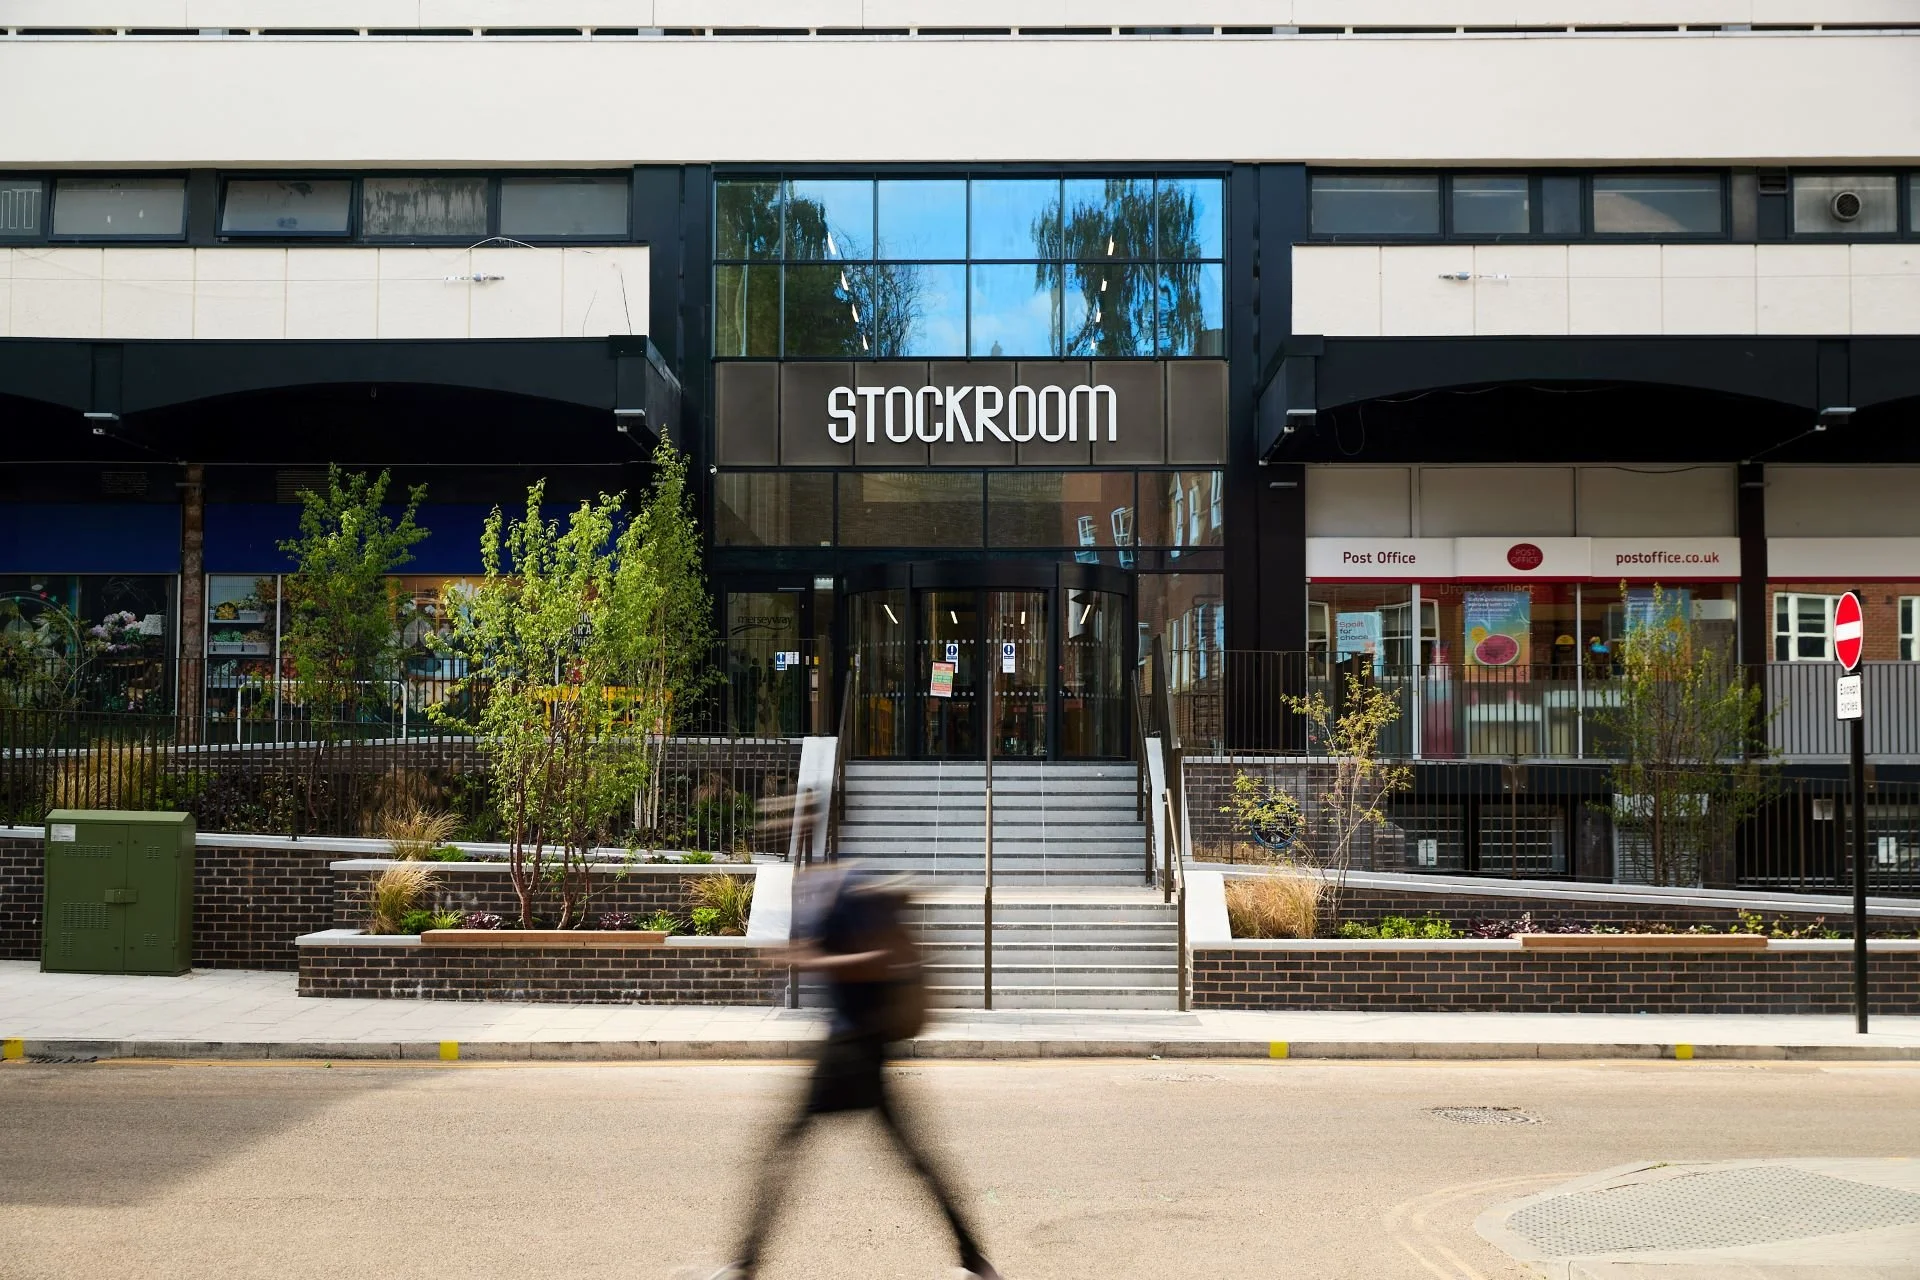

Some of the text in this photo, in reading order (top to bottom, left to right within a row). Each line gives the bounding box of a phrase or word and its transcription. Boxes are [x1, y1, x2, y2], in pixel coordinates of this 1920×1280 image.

[828, 385, 1117, 443] STOCKROOM
[1343, 551, 1416, 564] Post Office
[1510, 556, 1541, 564] OFFICE
[1616, 551, 1720, 566] postoffice.co.uk
[737, 615, 792, 627] merseyway
[1339, 621, 1364, 629] Spoilt
